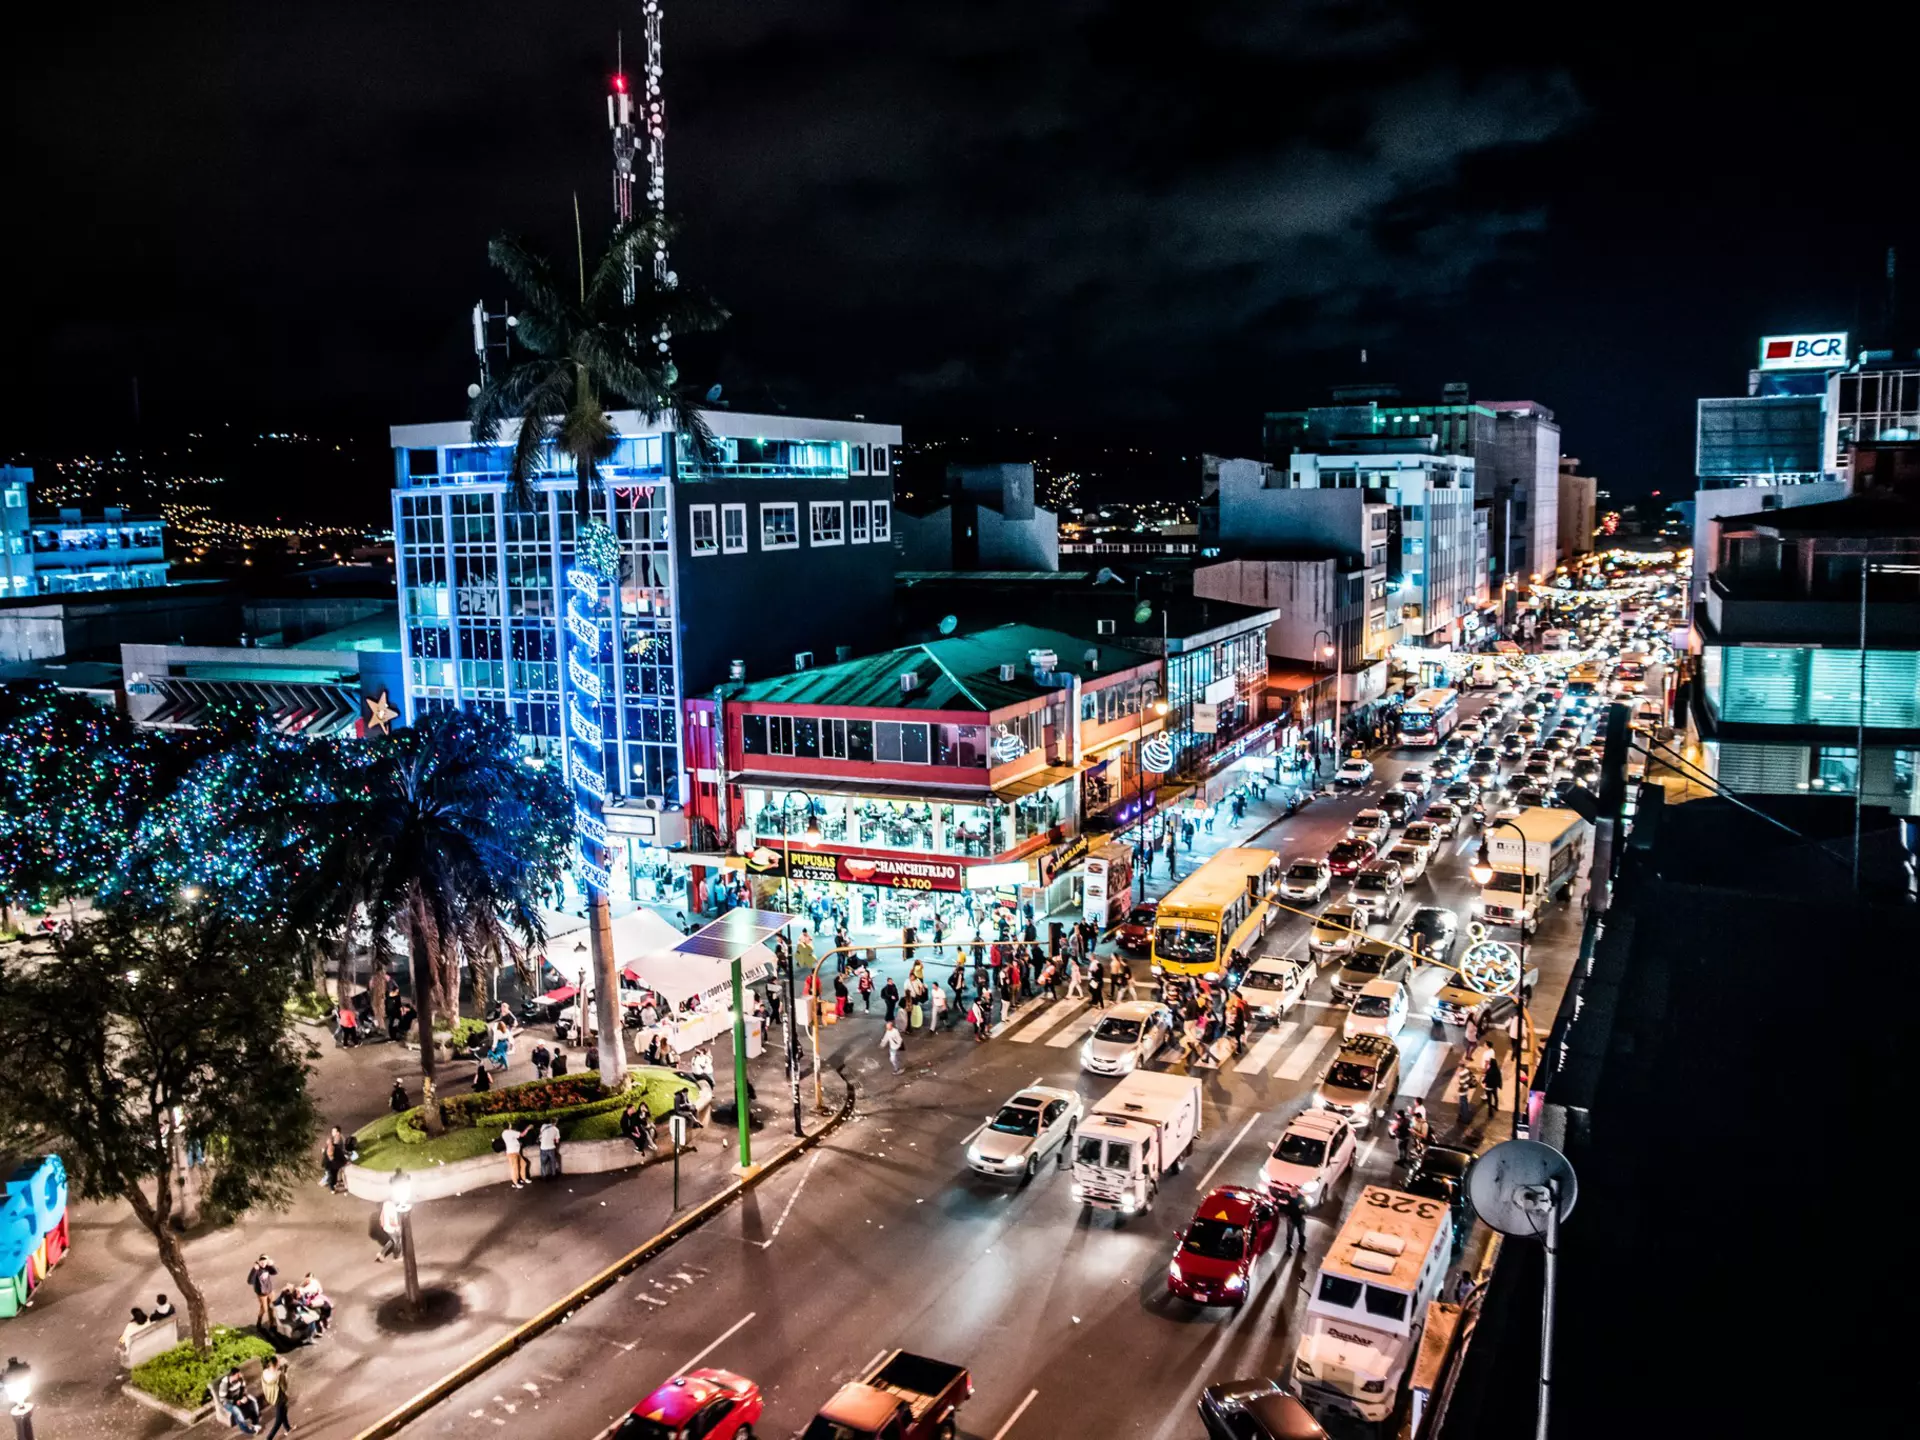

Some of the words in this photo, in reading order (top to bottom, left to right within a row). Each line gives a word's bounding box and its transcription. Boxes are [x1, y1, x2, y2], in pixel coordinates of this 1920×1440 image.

[1795, 338, 1842, 357] BCR
[791, 853, 836, 868] PUPUSAS
[812, 871, 836, 881] 2.200
[874, 860, 956, 879] CHANCHIFRIJO
[901, 877, 932, 890] 3.700
[1366, 1191, 1440, 1220] 326
